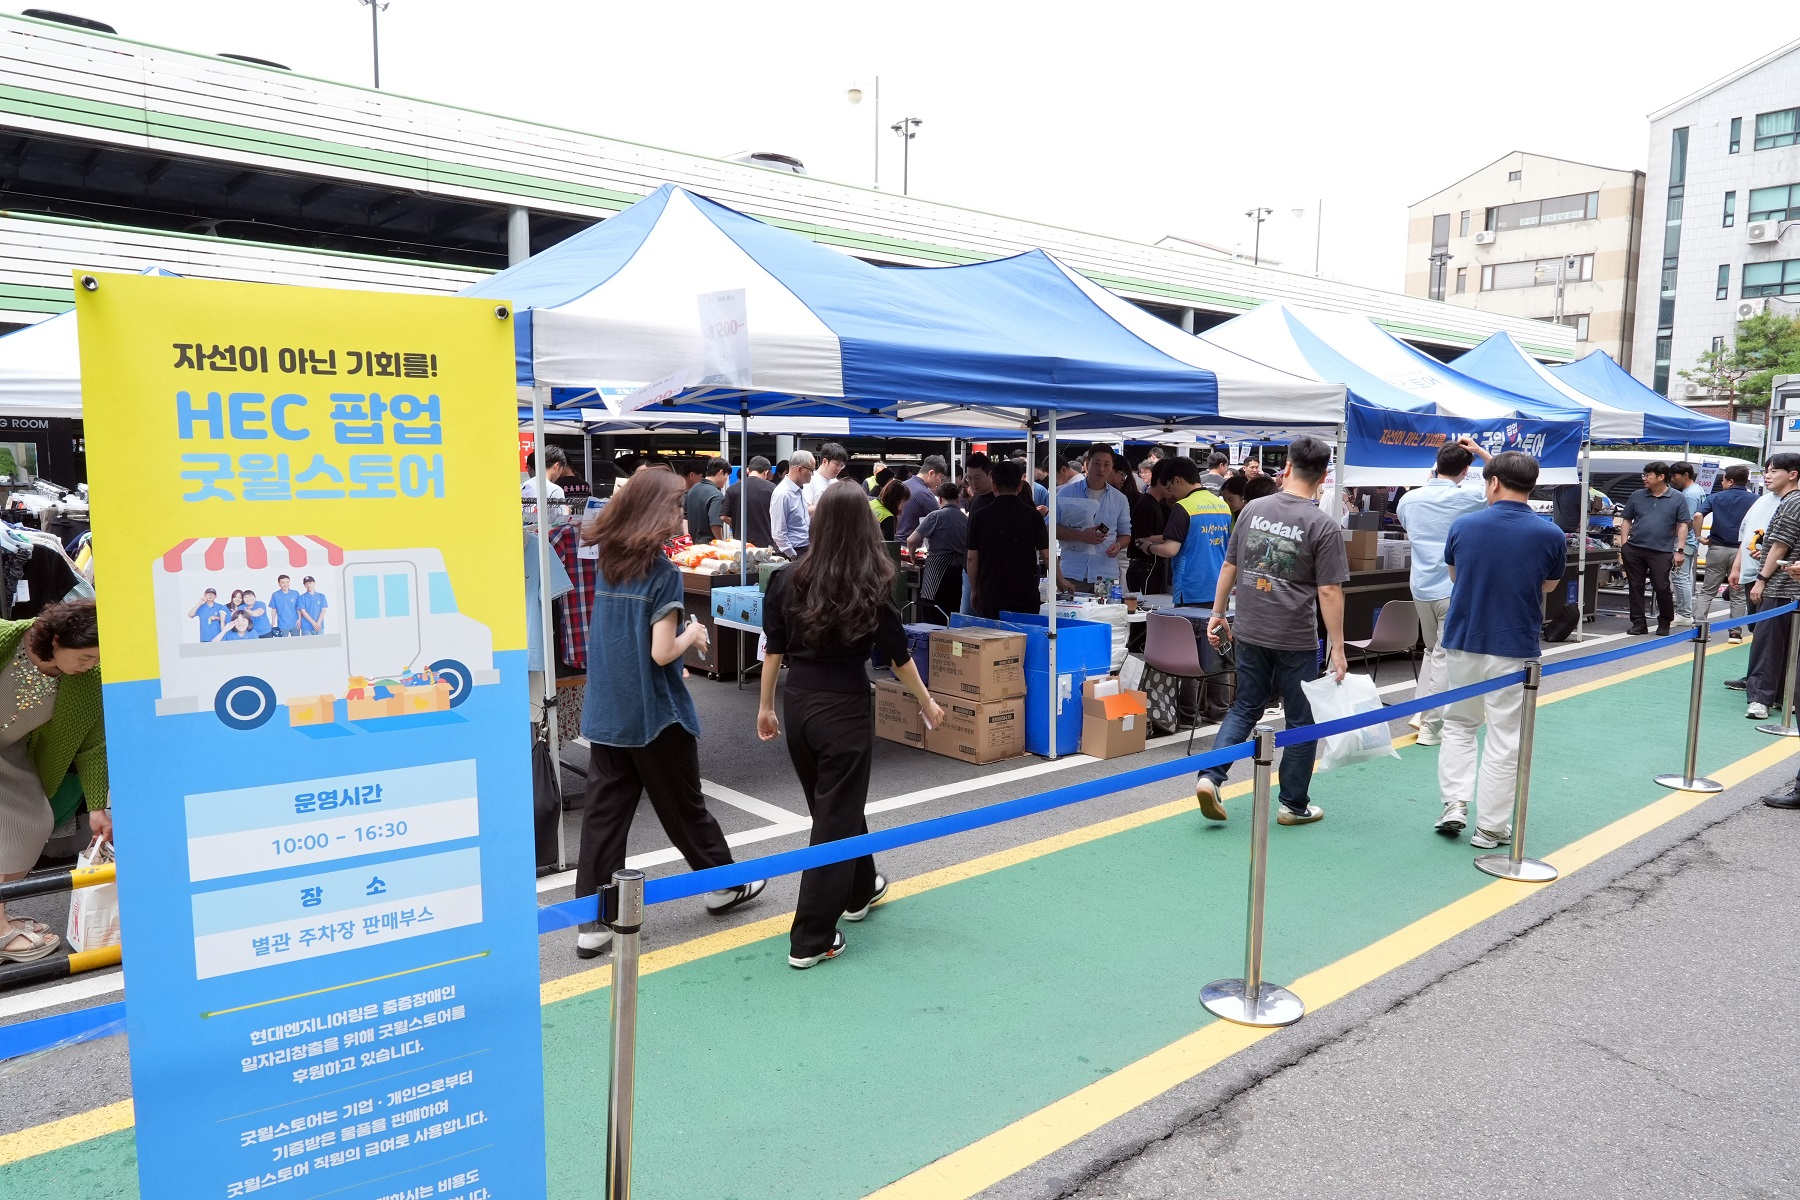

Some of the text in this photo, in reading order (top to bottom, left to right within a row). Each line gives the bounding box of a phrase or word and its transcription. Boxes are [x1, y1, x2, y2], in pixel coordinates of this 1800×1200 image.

[172, 342, 438, 379] 자선이 아닌 기회를!
[12, 418, 49, 429] ROOM
[176, 390, 442, 445] HEC 팝업
[1379, 429, 1407, 445] 자선이
[1404, 431, 1425, 446] 아닌
[179, 452, 445, 503] 굿윌스토어
[1250, 515, 1305, 542] Kodak
[294, 783, 384, 815] 운영시간
[271, 831, 329, 856] 10:00
[353, 820, 408, 843] 16:30
[300, 875, 387, 908] 장 소
[252, 904, 435, 958] 별관 주차장 판매부스
[240, 1004, 466, 1073] 일자리창출을 위해 굿윌스토어를
[250, 984, 456, 1047] 현대엔지니어링은 중증장애인
[292, 1038, 425, 1084] 후원하고 있습니다.
[240, 1110, 338, 1148] 굿윌스토어는
[342, 1098, 374, 1119] 기업
[386, 1069, 474, 1107] 개인으로부터
[272, 1099, 449, 1162] 기증받은 물품을 판매하여
[226, 1110, 488, 1199] 굿윌스토어 직원의 급여로 사용합니다.
[375, 1182, 434, 1200] 하시는
[437, 1168, 480, 1193] 비용도
